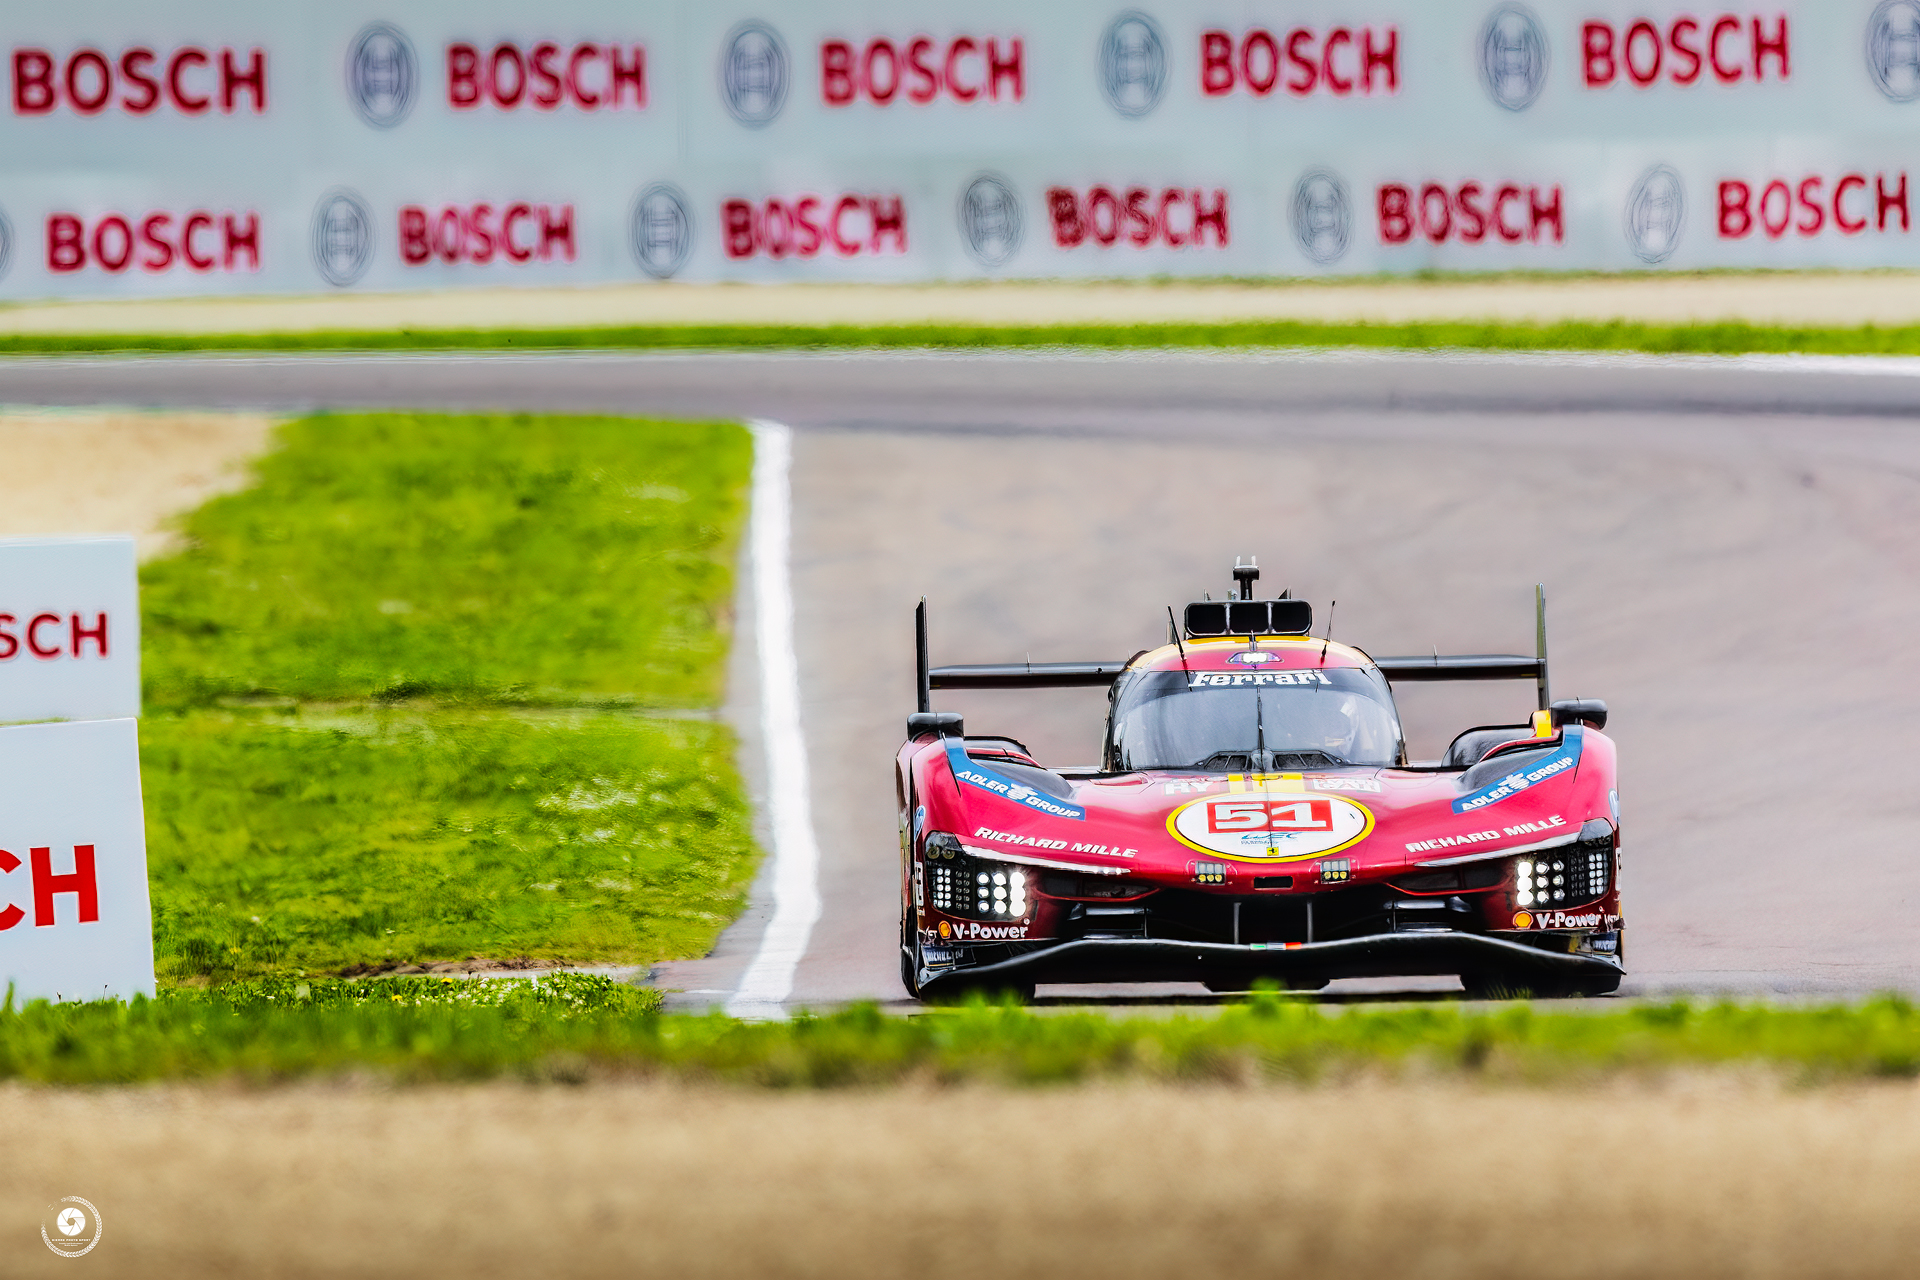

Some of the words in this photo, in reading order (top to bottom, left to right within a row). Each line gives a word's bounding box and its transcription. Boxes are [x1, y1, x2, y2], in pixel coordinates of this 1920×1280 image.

[449, 45, 645, 109] BOSCH
[822, 38, 1023, 105] BOSCH
[1201, 29, 1398, 96] BOSCH
[1582, 15, 1790, 87] BOSCH
[13, 49, 264, 115] BOSCH
[400, 205, 574, 264] BOSCH
[723, 197, 905, 258] BOSCH
[1047, 187, 1227, 247] BOSCH
[1378, 182, 1563, 244] BOSCH
[1718, 174, 1909, 239] BOSCH
[47, 213, 259, 272] BOSCH
[1188, 671, 1332, 687] Ferrari
[956, 771, 1009, 793] ADLER
[1025, 796, 1081, 818] GROUP
[1461, 787, 1513, 811] ADLER
[1526, 757, 1573, 782] GROUP
[974, 827, 1068, 850] RICHARD
[1071, 842, 1138, 858] MILLE
[1215, 803, 1327, 829] 51
[1405, 830, 1501, 853] RICHARD
[1503, 815, 1567, 836] MILLE
[952, 922, 1029, 939] V-Power
[1536, 912, 1602, 929] V-Power
